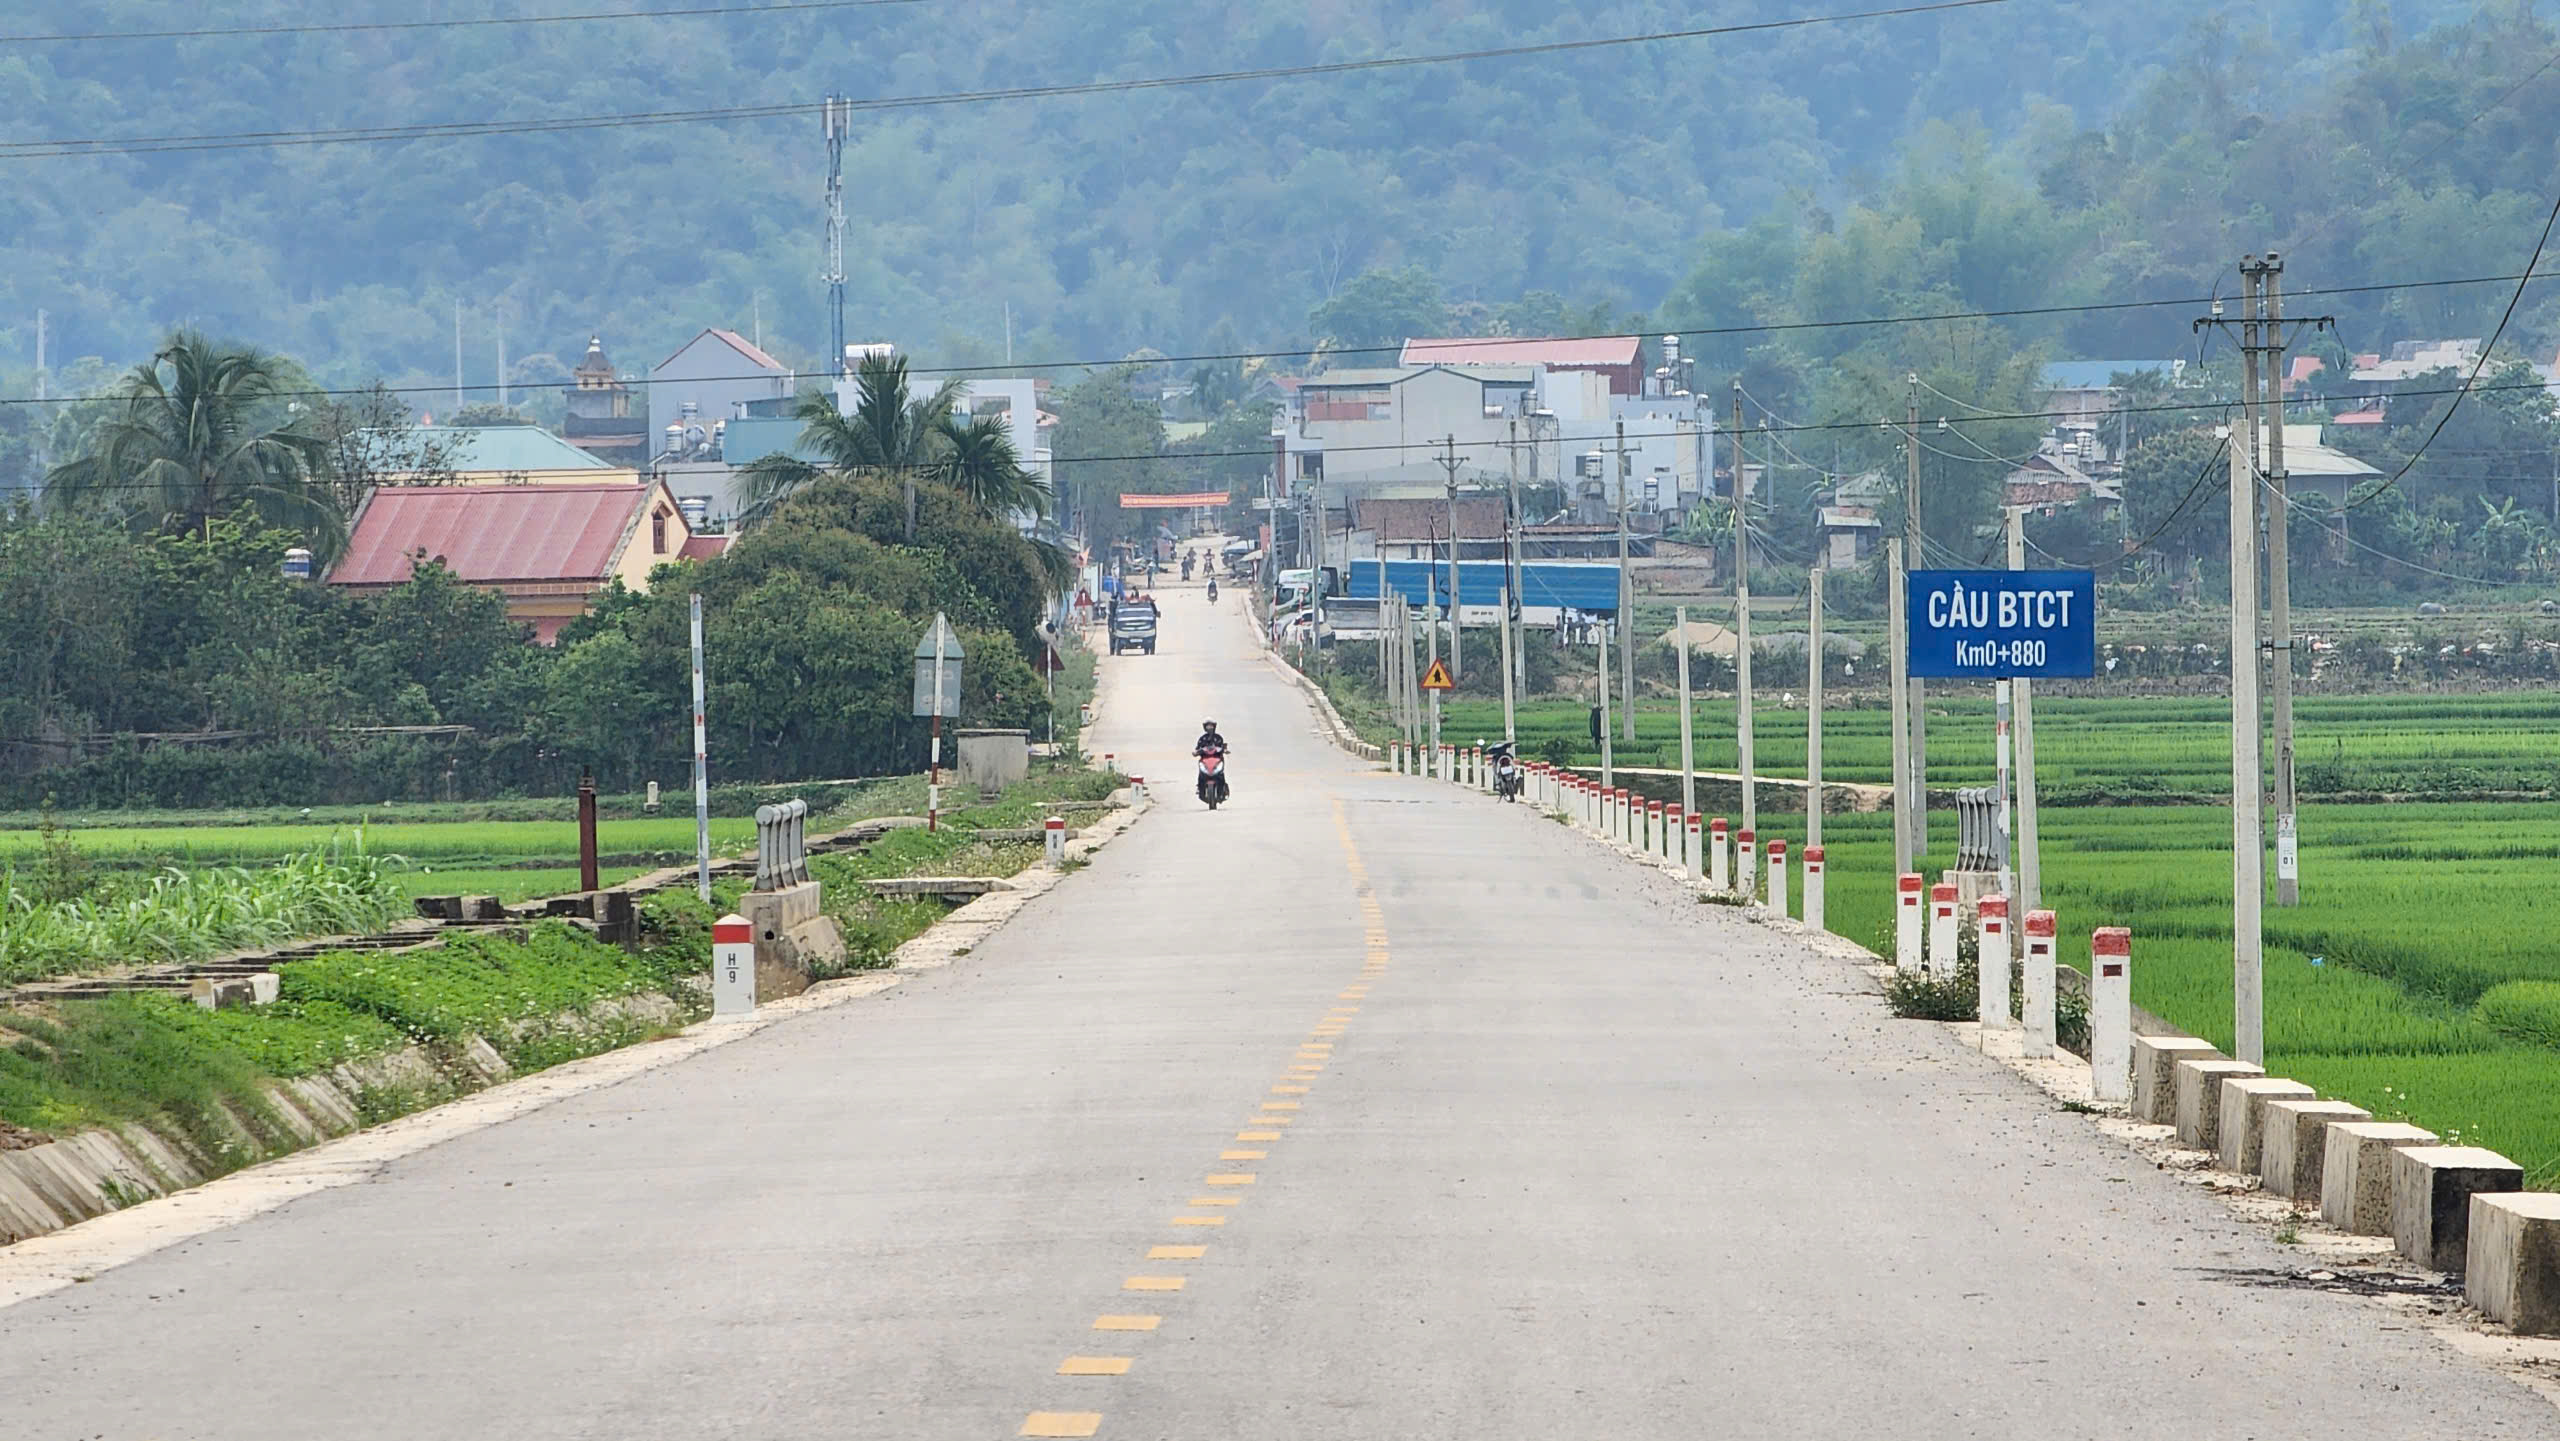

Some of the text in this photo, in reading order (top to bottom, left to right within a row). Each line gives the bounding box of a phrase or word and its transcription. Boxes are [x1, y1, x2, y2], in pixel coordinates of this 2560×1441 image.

[1928, 580, 2074, 628] CẦU BTCT
[1956, 639, 2046, 667] Km0+880
[727, 953, 736, 966] H
[728, 970, 736, 984] 9
